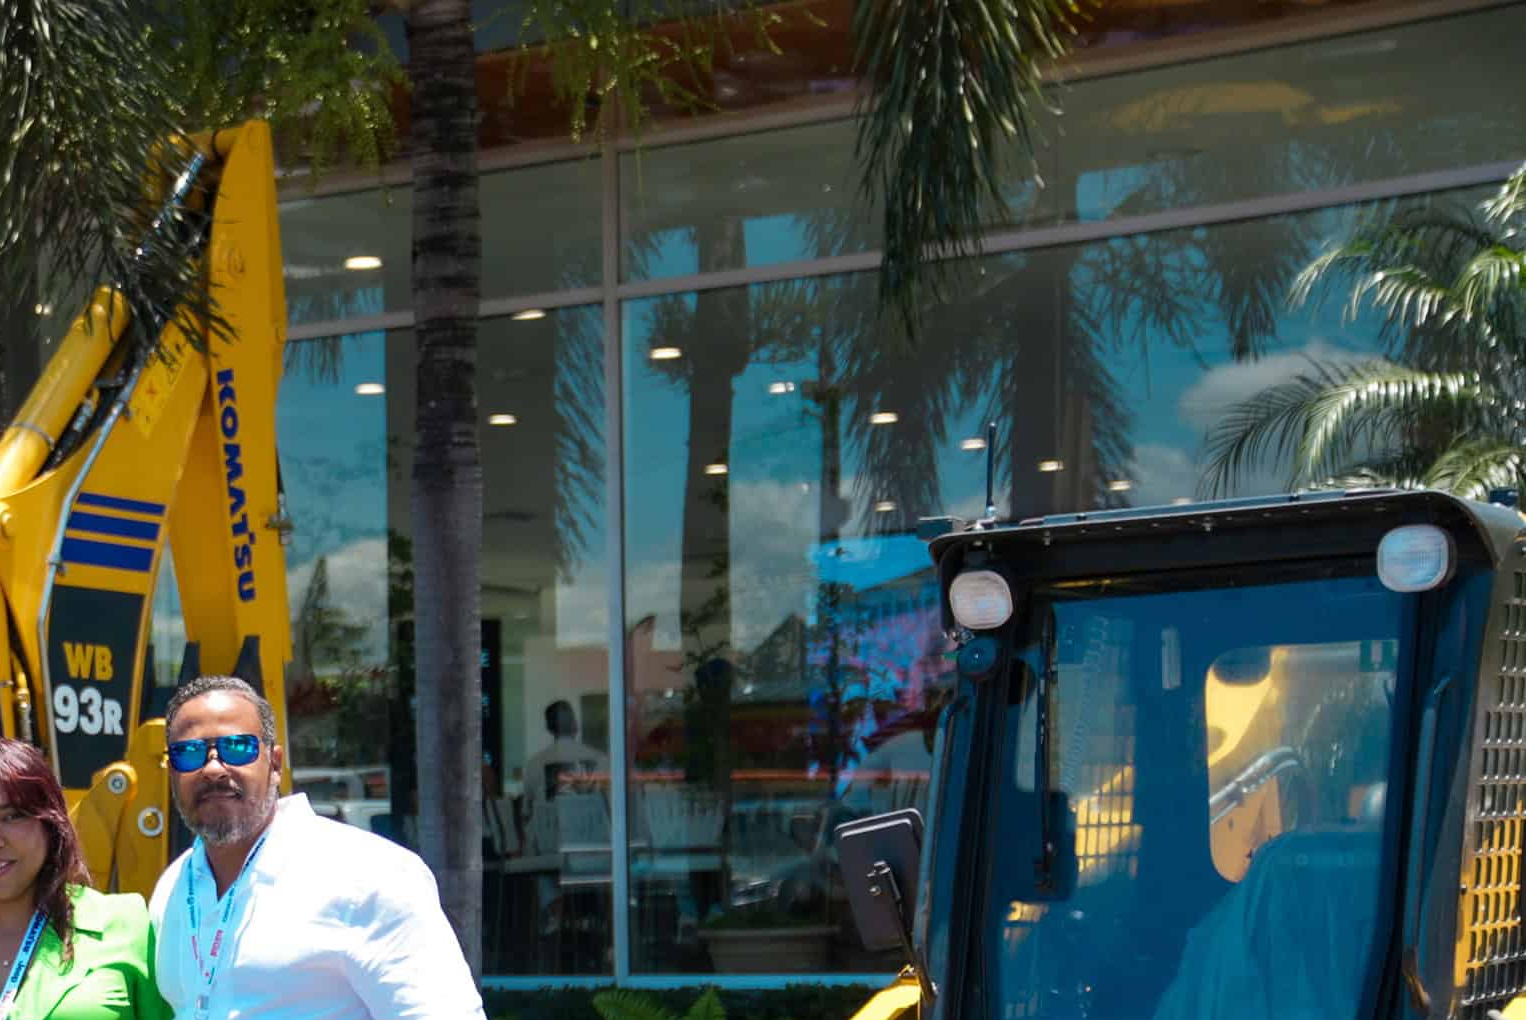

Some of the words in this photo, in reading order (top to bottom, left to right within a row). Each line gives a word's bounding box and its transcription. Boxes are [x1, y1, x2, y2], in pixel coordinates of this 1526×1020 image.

[217, 368, 255, 603] KOMATSU
[63, 642, 113, 682] WB
[53, 684, 124, 736] 93R
